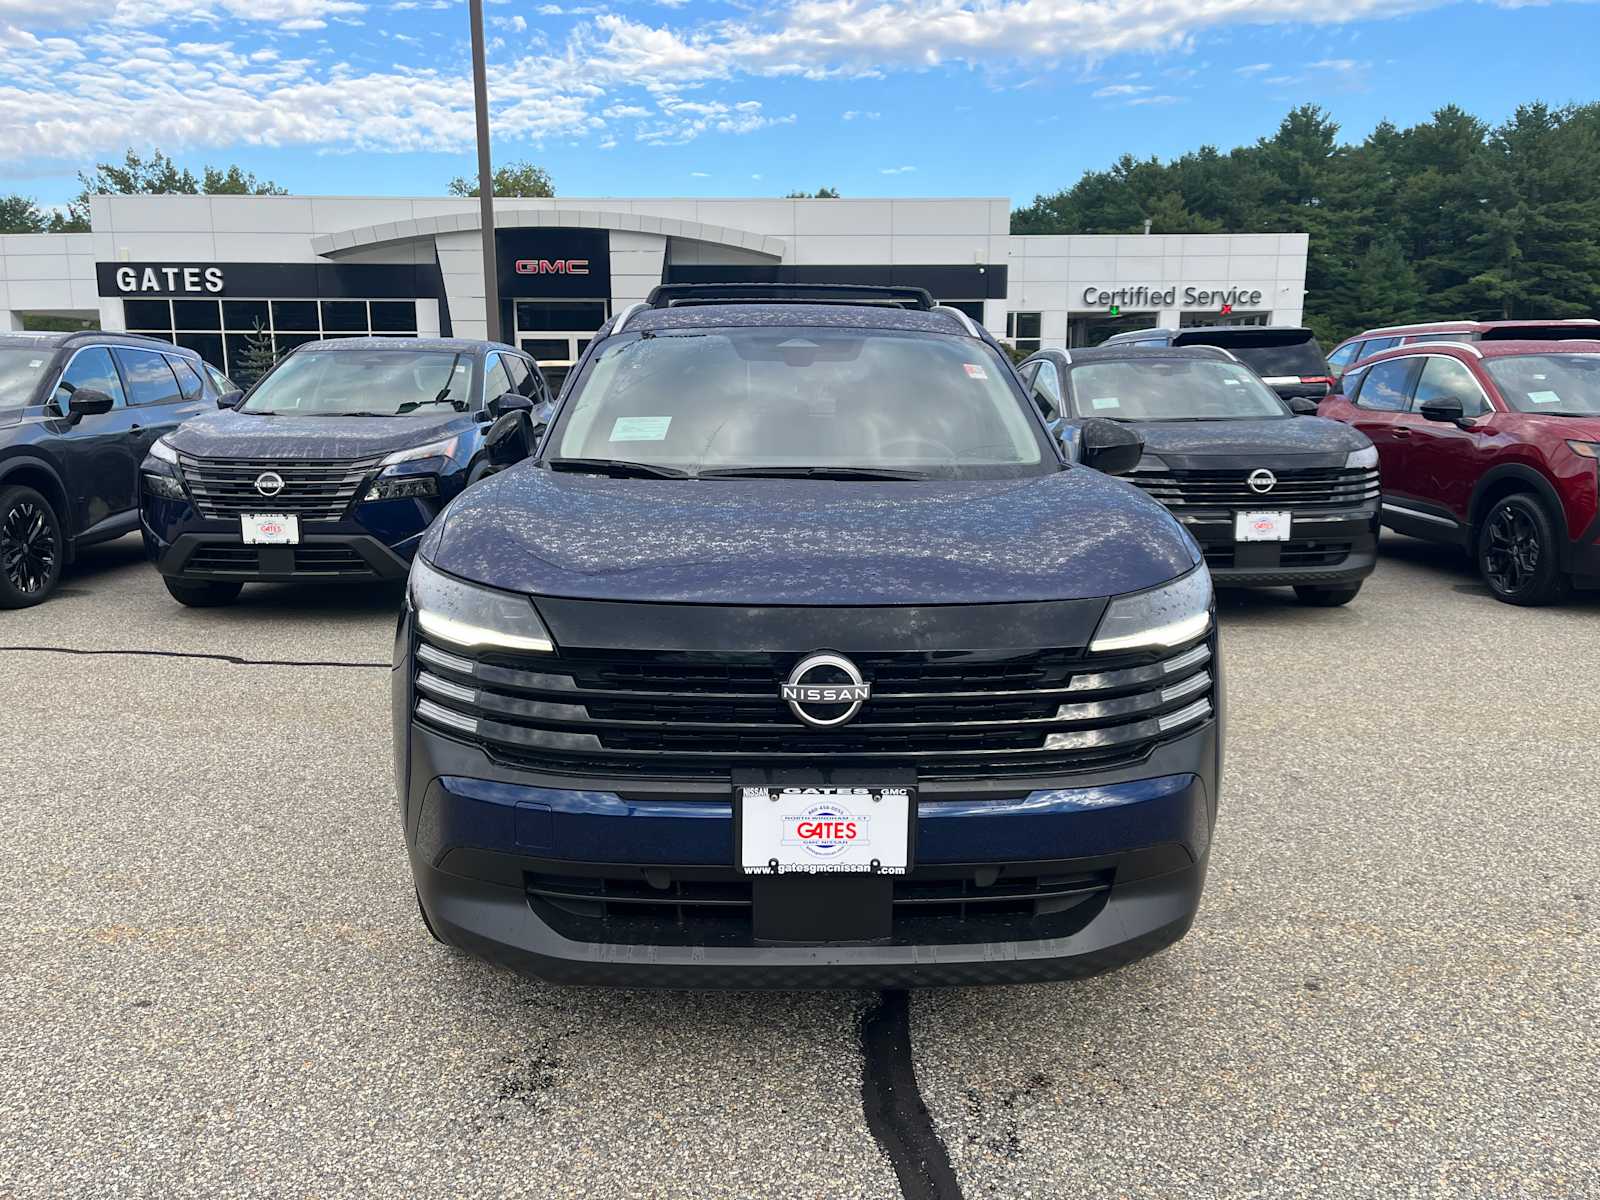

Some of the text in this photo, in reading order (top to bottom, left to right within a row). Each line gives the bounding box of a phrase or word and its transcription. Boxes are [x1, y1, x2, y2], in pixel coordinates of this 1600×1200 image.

[515, 259, 589, 274] GMC
[116, 267, 223, 292] GATES
[1083, 286, 1262, 306] Certified Service
[783, 687, 868, 701] NISSAN
[743, 787, 768, 797] NISSAN
[783, 787, 869, 795] GATES
[797, 822, 857, 839] GATES
